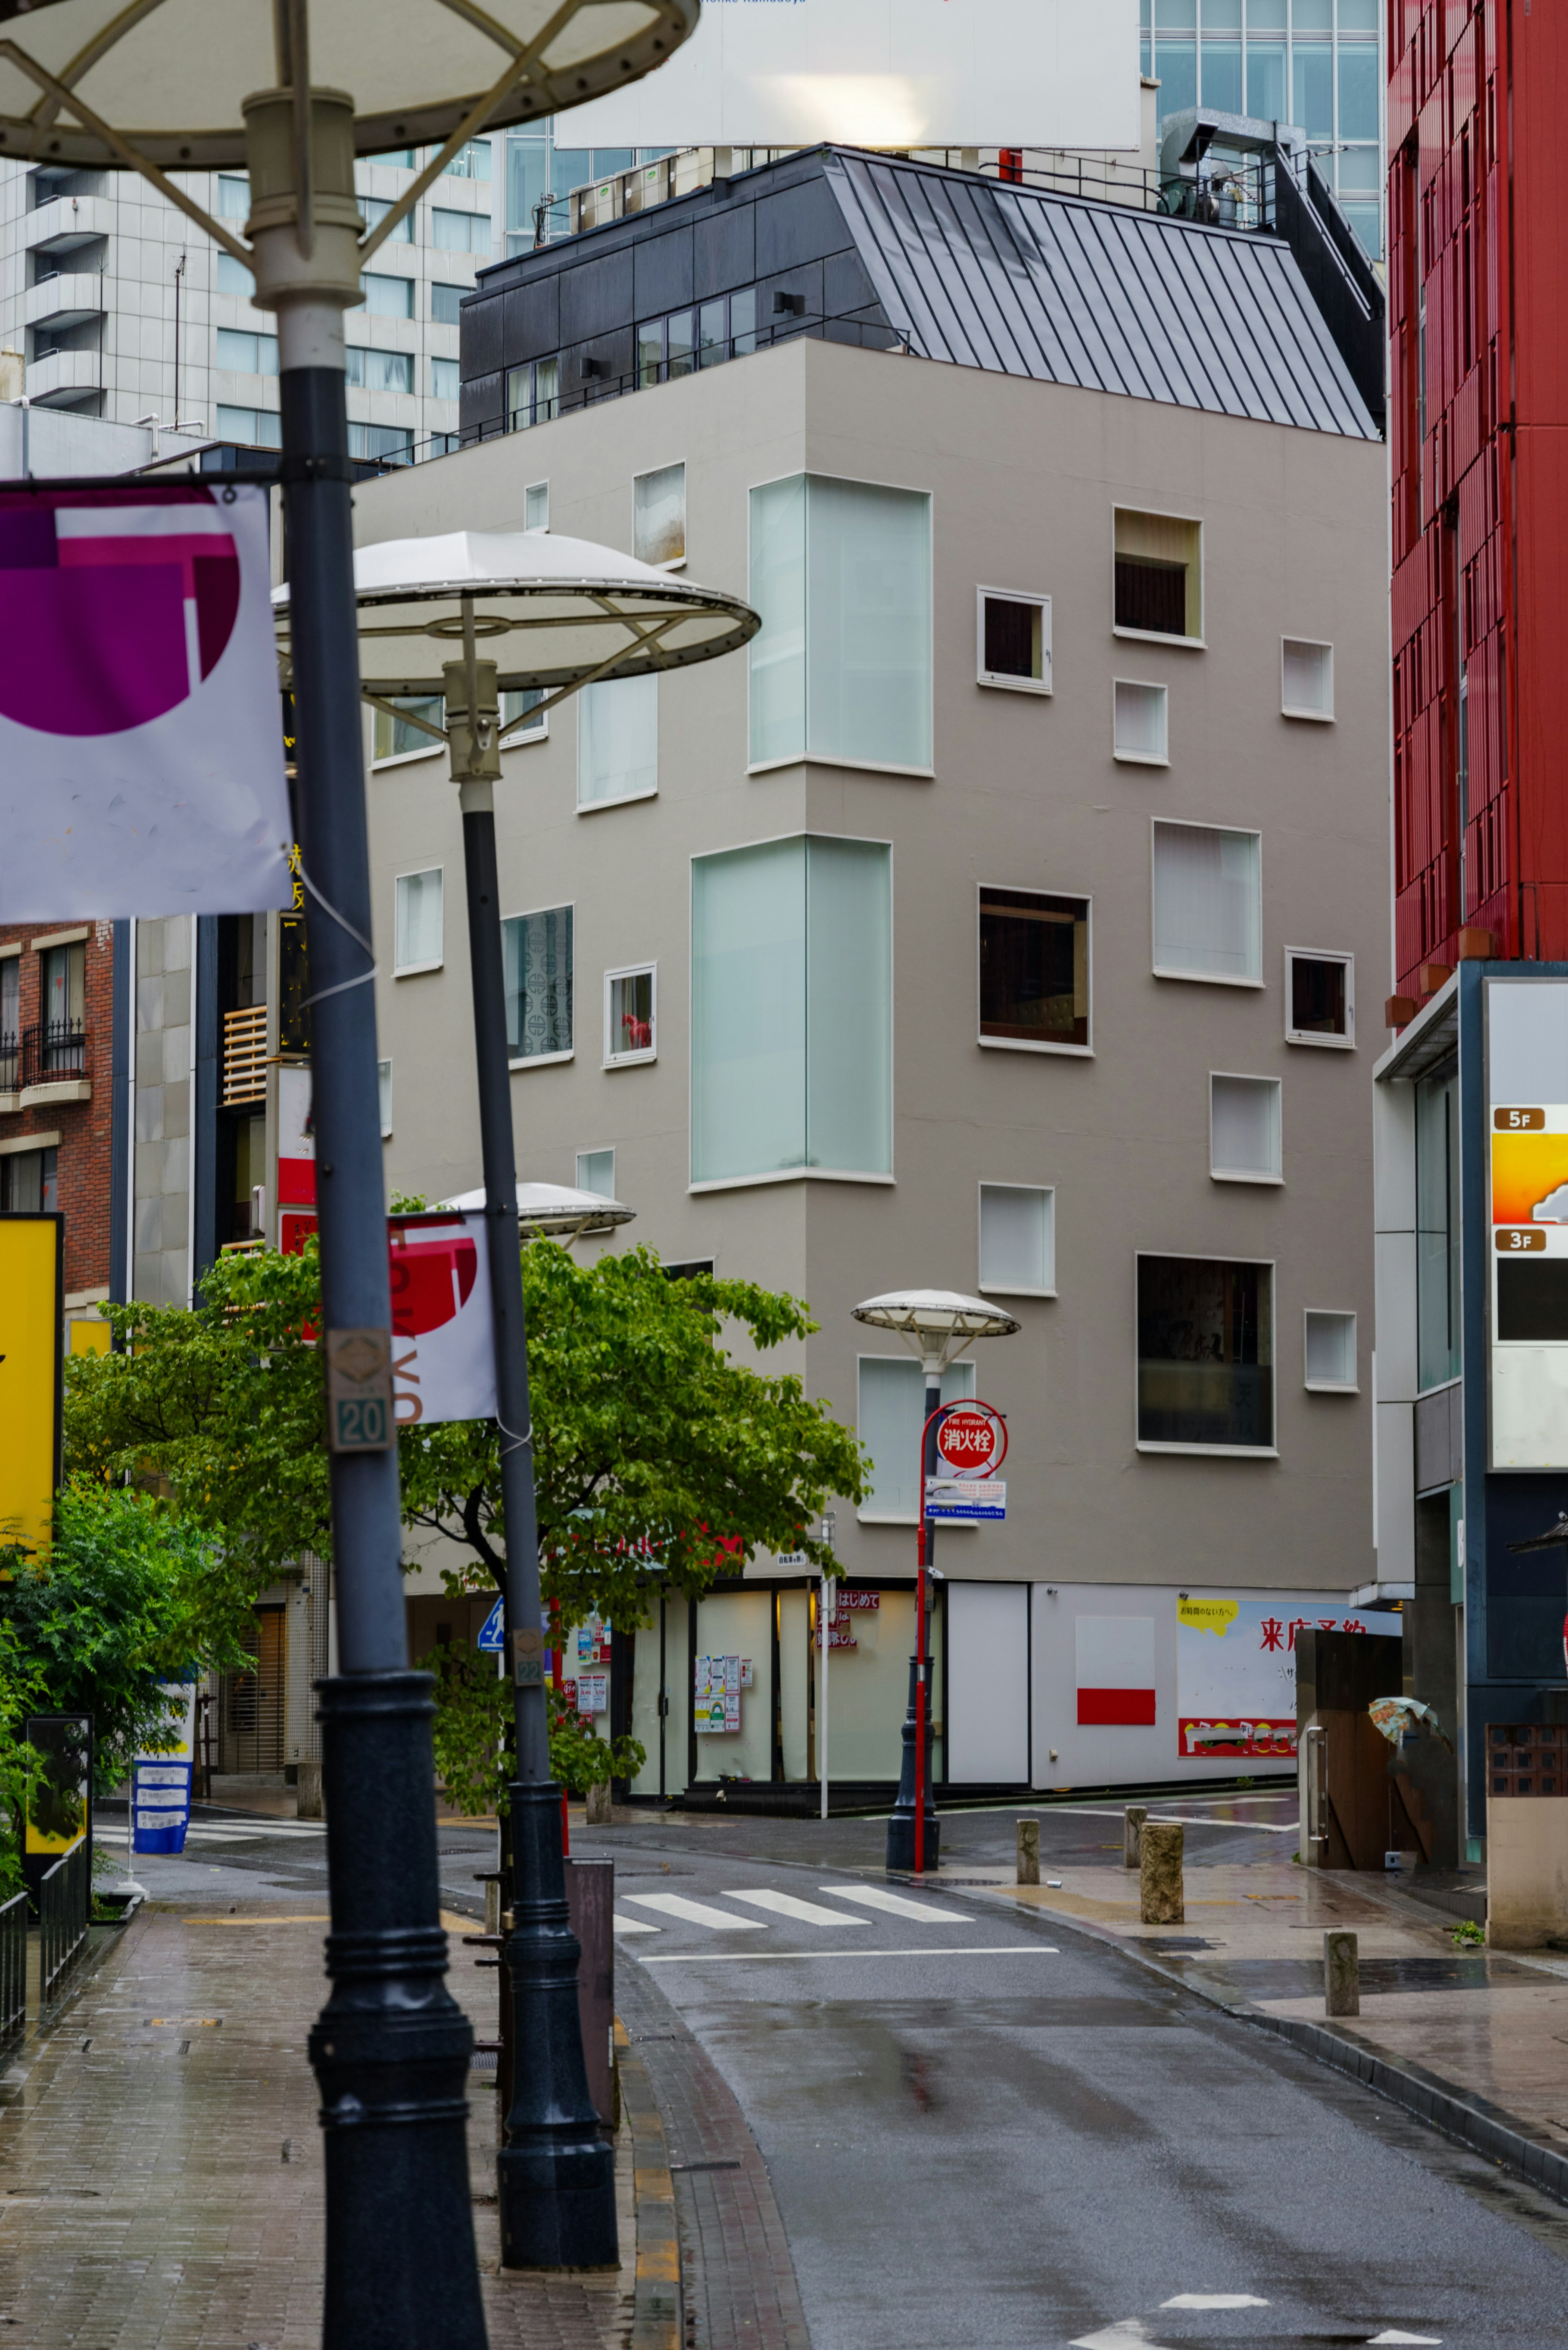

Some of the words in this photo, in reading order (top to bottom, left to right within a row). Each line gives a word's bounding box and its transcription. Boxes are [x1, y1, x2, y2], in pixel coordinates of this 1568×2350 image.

[1509, 1111, 1530, 1127] 5F
[1510, 1232, 1532, 1249] 3F
[343, 1401, 381, 1440] 20
[944, 1429, 991, 1452] 消火栓
[1180, 1607, 1233, 1616] お時間のない方へ。
[520, 1663, 538, 1681] 22
